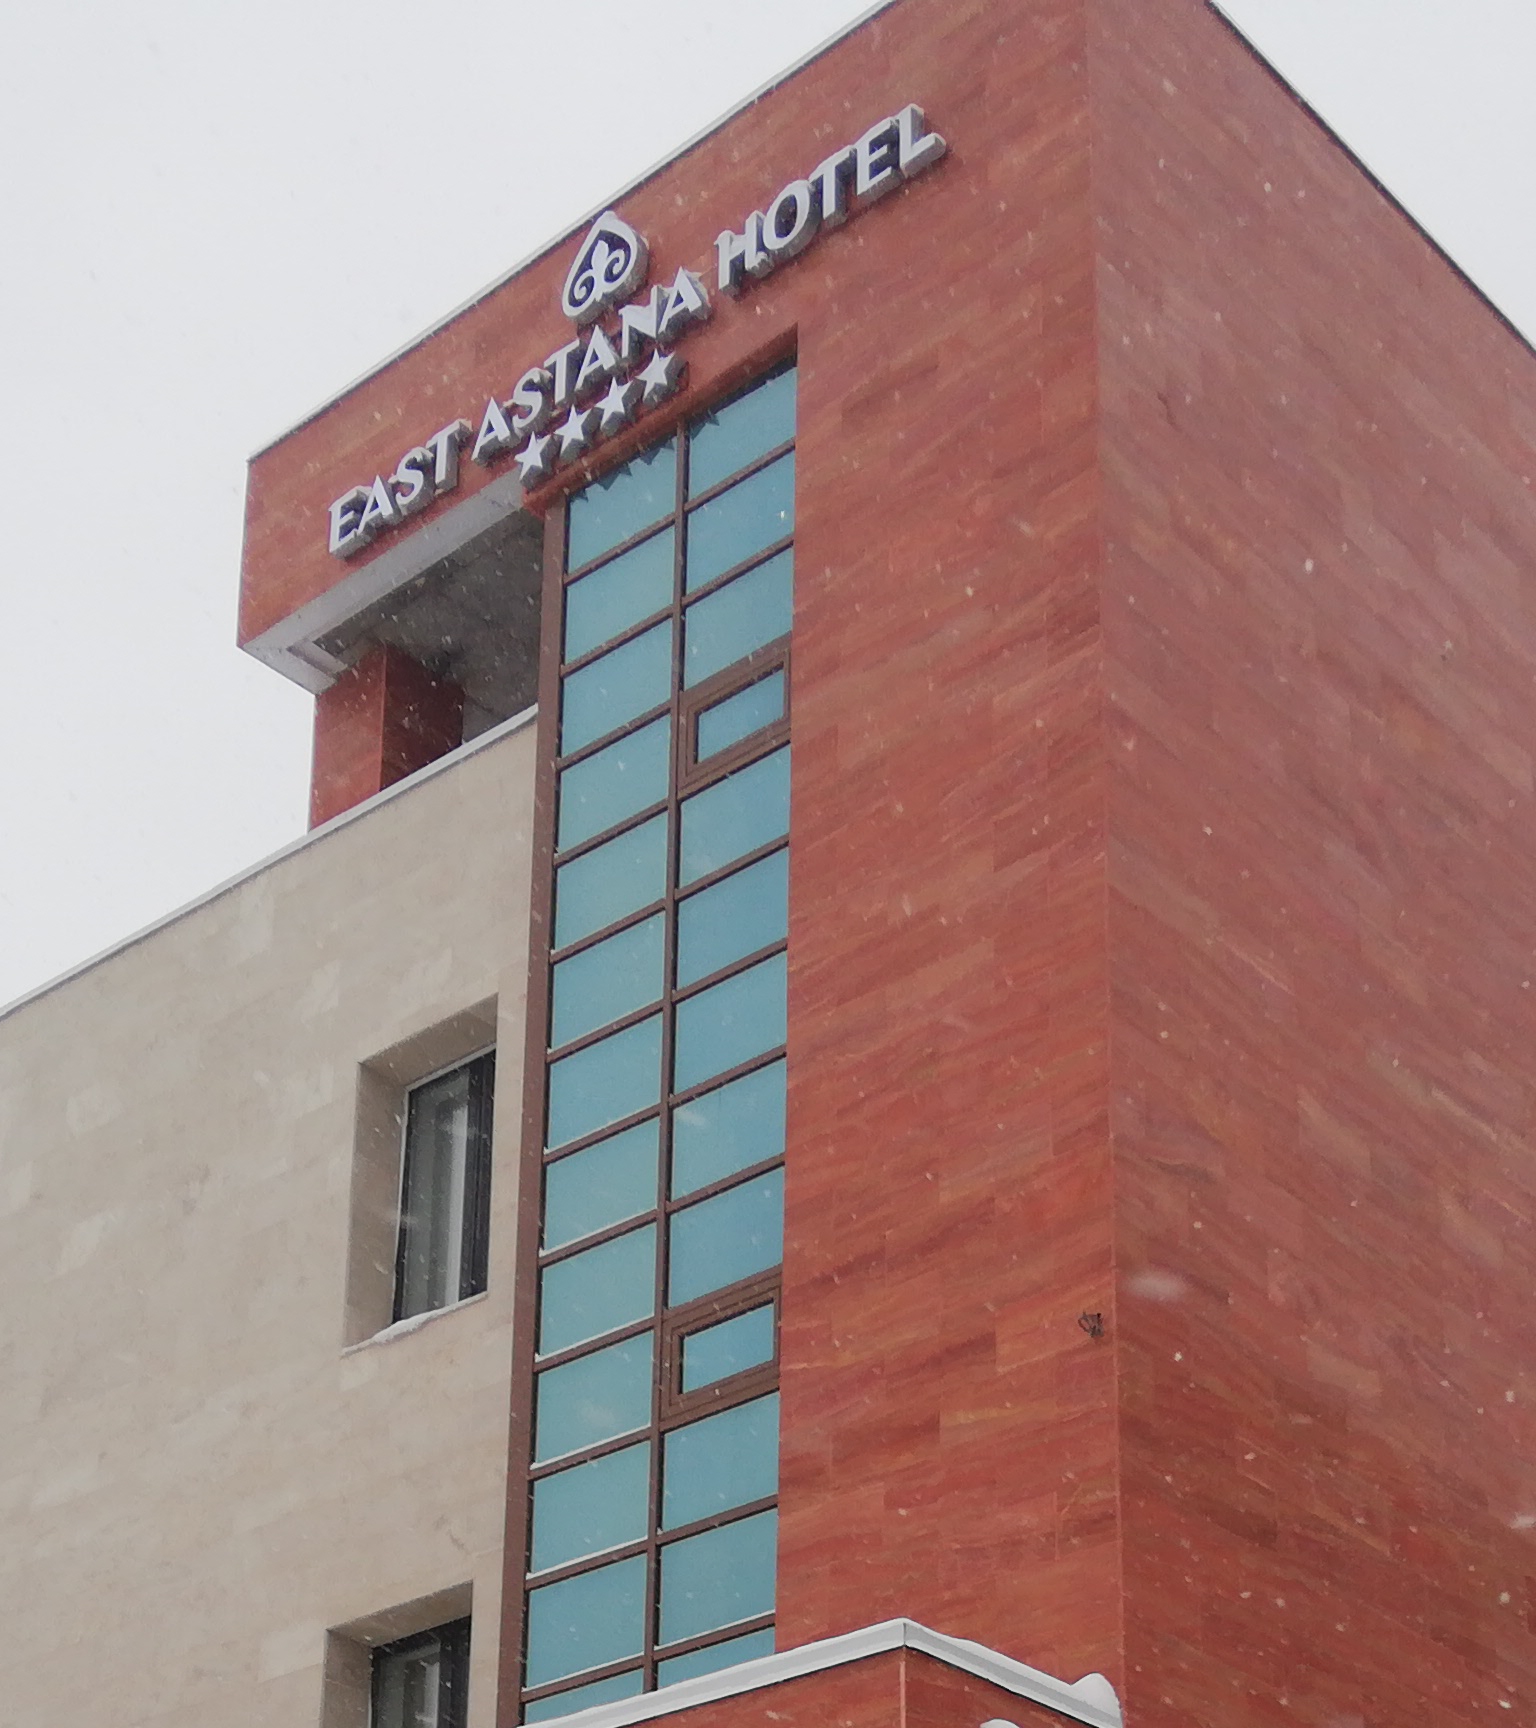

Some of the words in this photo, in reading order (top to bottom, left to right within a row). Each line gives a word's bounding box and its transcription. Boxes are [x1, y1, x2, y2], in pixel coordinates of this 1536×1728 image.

[328, 419, 470, 558] EAST
[472, 267, 711, 465] ASTANA
[717, 104, 945, 297] HOTEL
